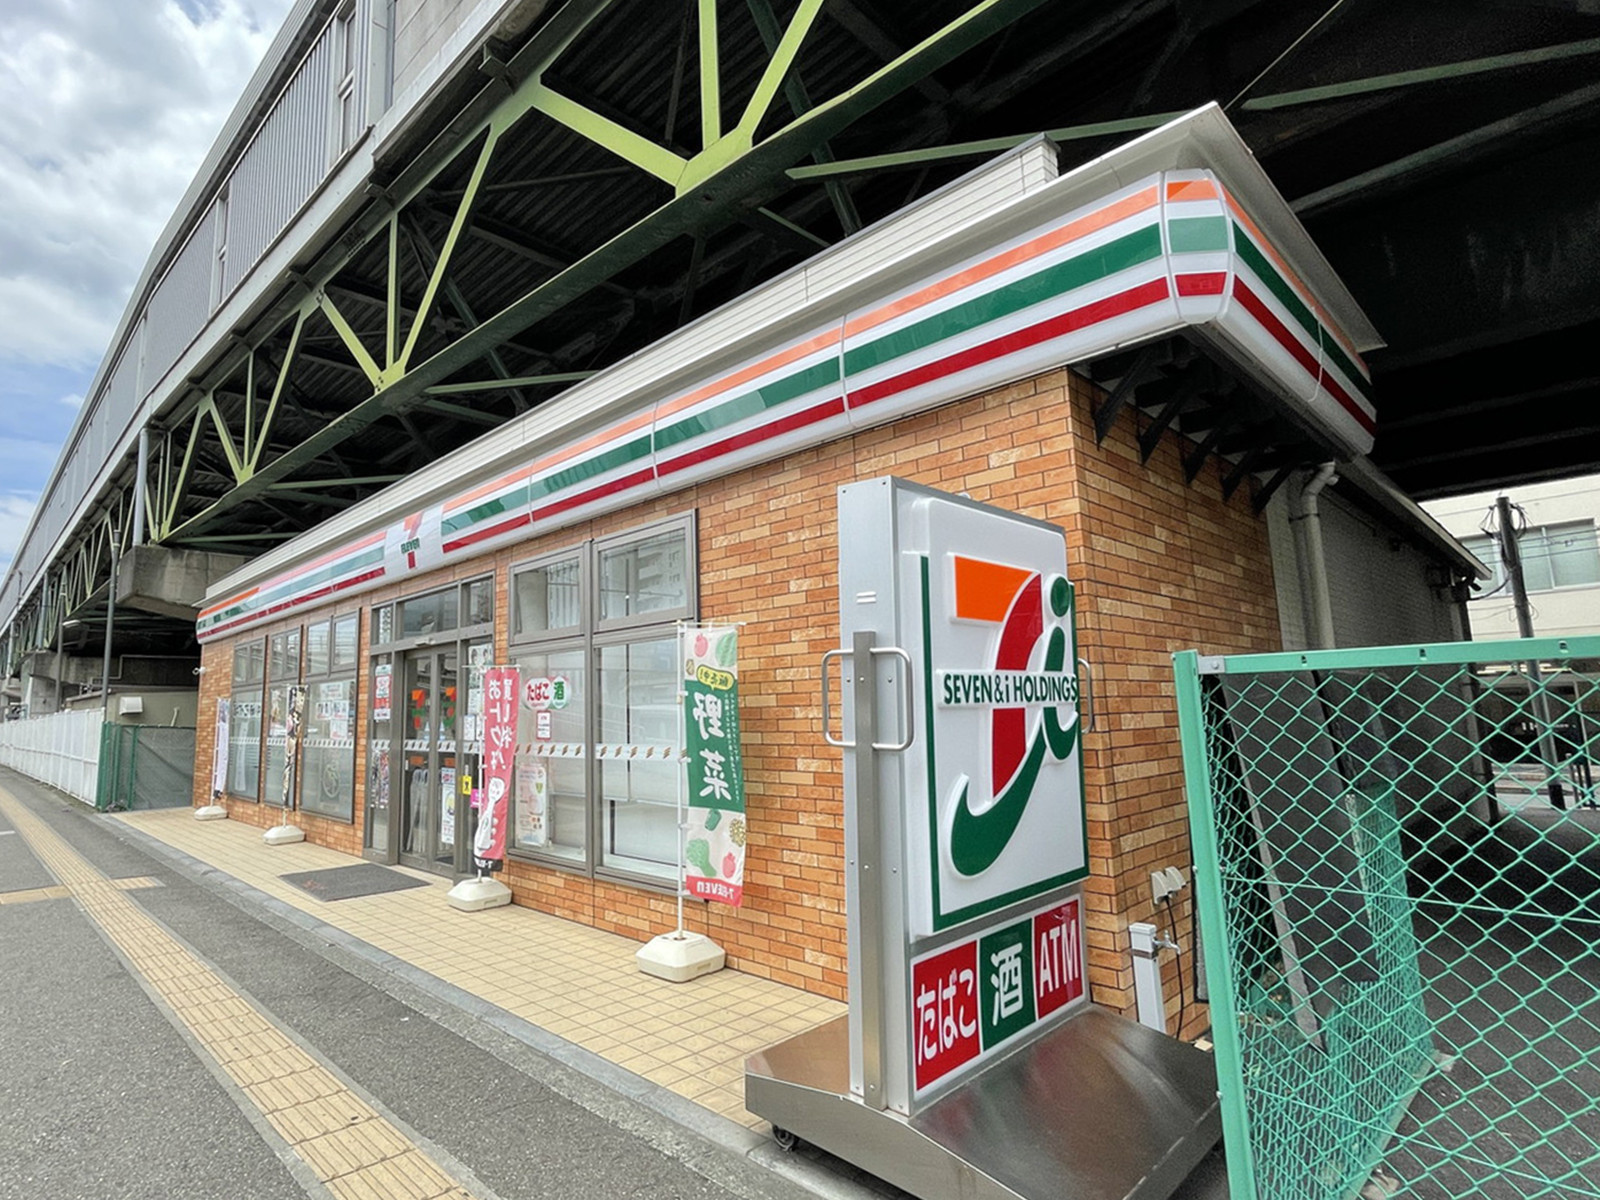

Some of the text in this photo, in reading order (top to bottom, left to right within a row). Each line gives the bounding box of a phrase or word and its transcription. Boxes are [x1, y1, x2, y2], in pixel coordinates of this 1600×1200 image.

[527, 682, 550, 701] たばこ
[553, 681, 565, 700] 酒
[1013, 675, 1078, 702] HOLDINGS
[990, 942, 1024, 1027] 酒
[1040, 919, 1079, 998] ATM
[917, 967, 977, 1066] たばこ
